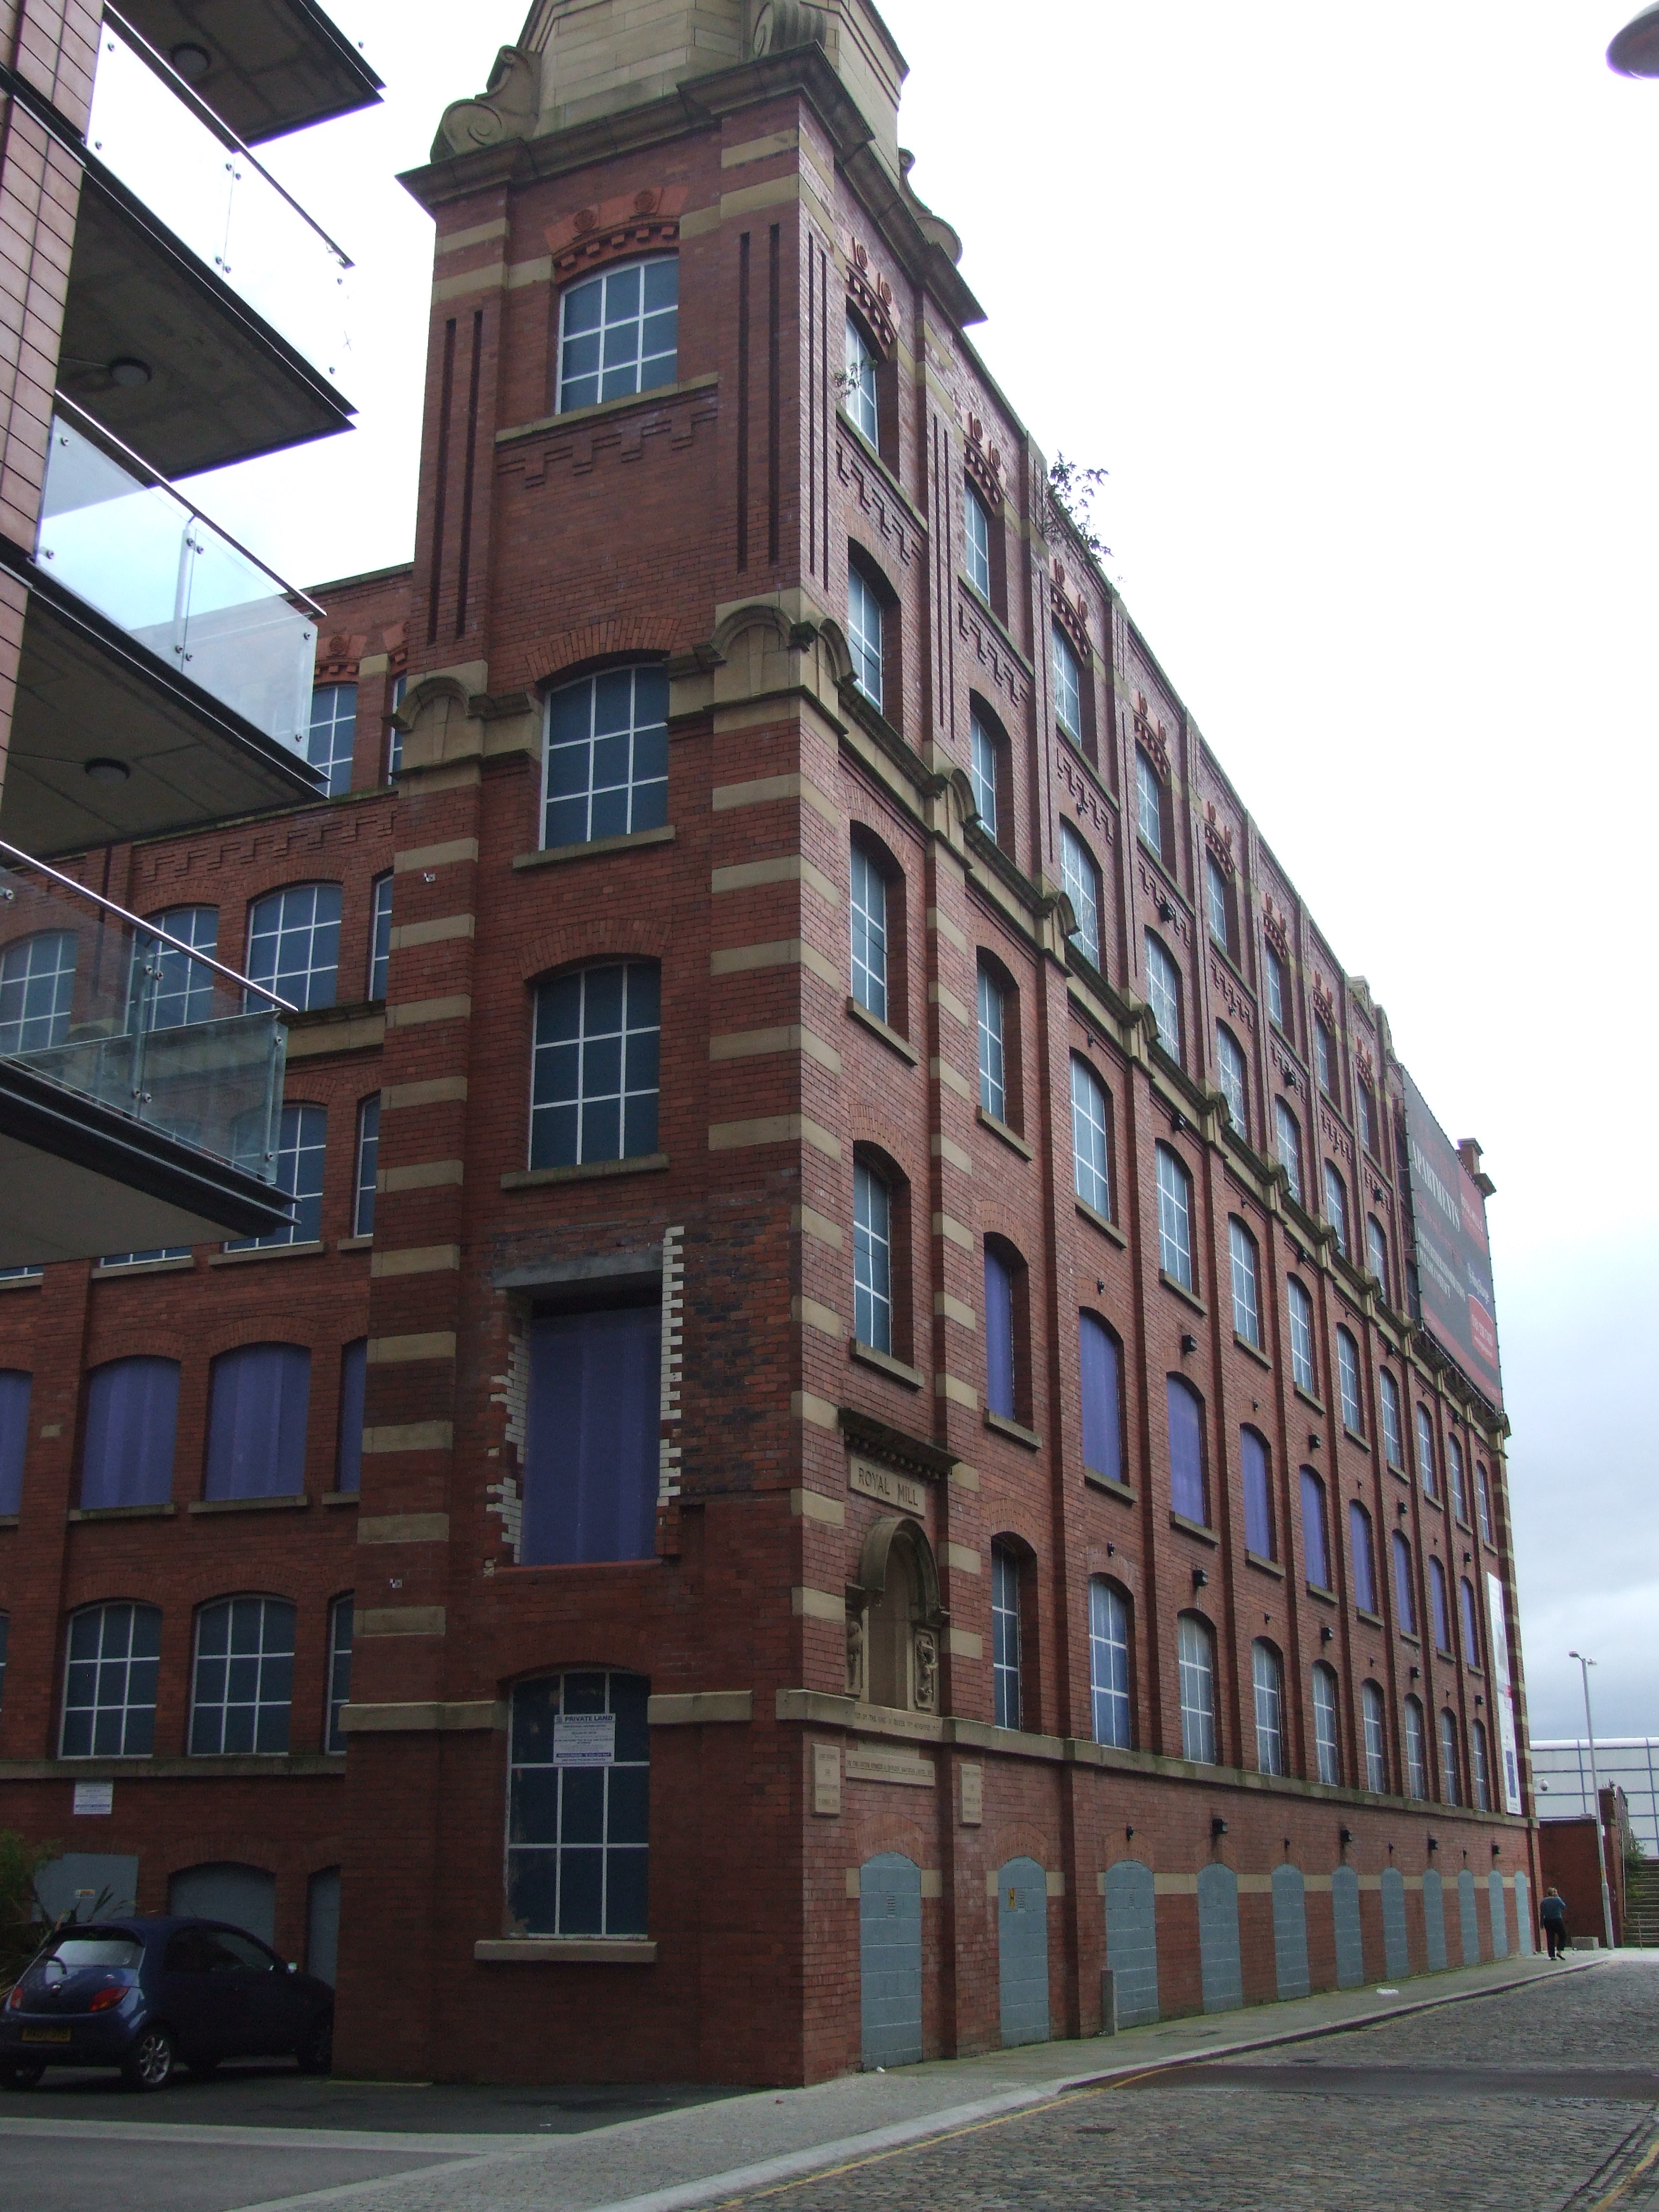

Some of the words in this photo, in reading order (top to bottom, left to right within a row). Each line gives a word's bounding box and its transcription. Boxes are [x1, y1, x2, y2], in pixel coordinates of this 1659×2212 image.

[1411, 1140, 1460, 1232] APARTMENTS
[859, 1467, 890, 1496] ROYAL
[897, 1483, 918, 1506] MILL
